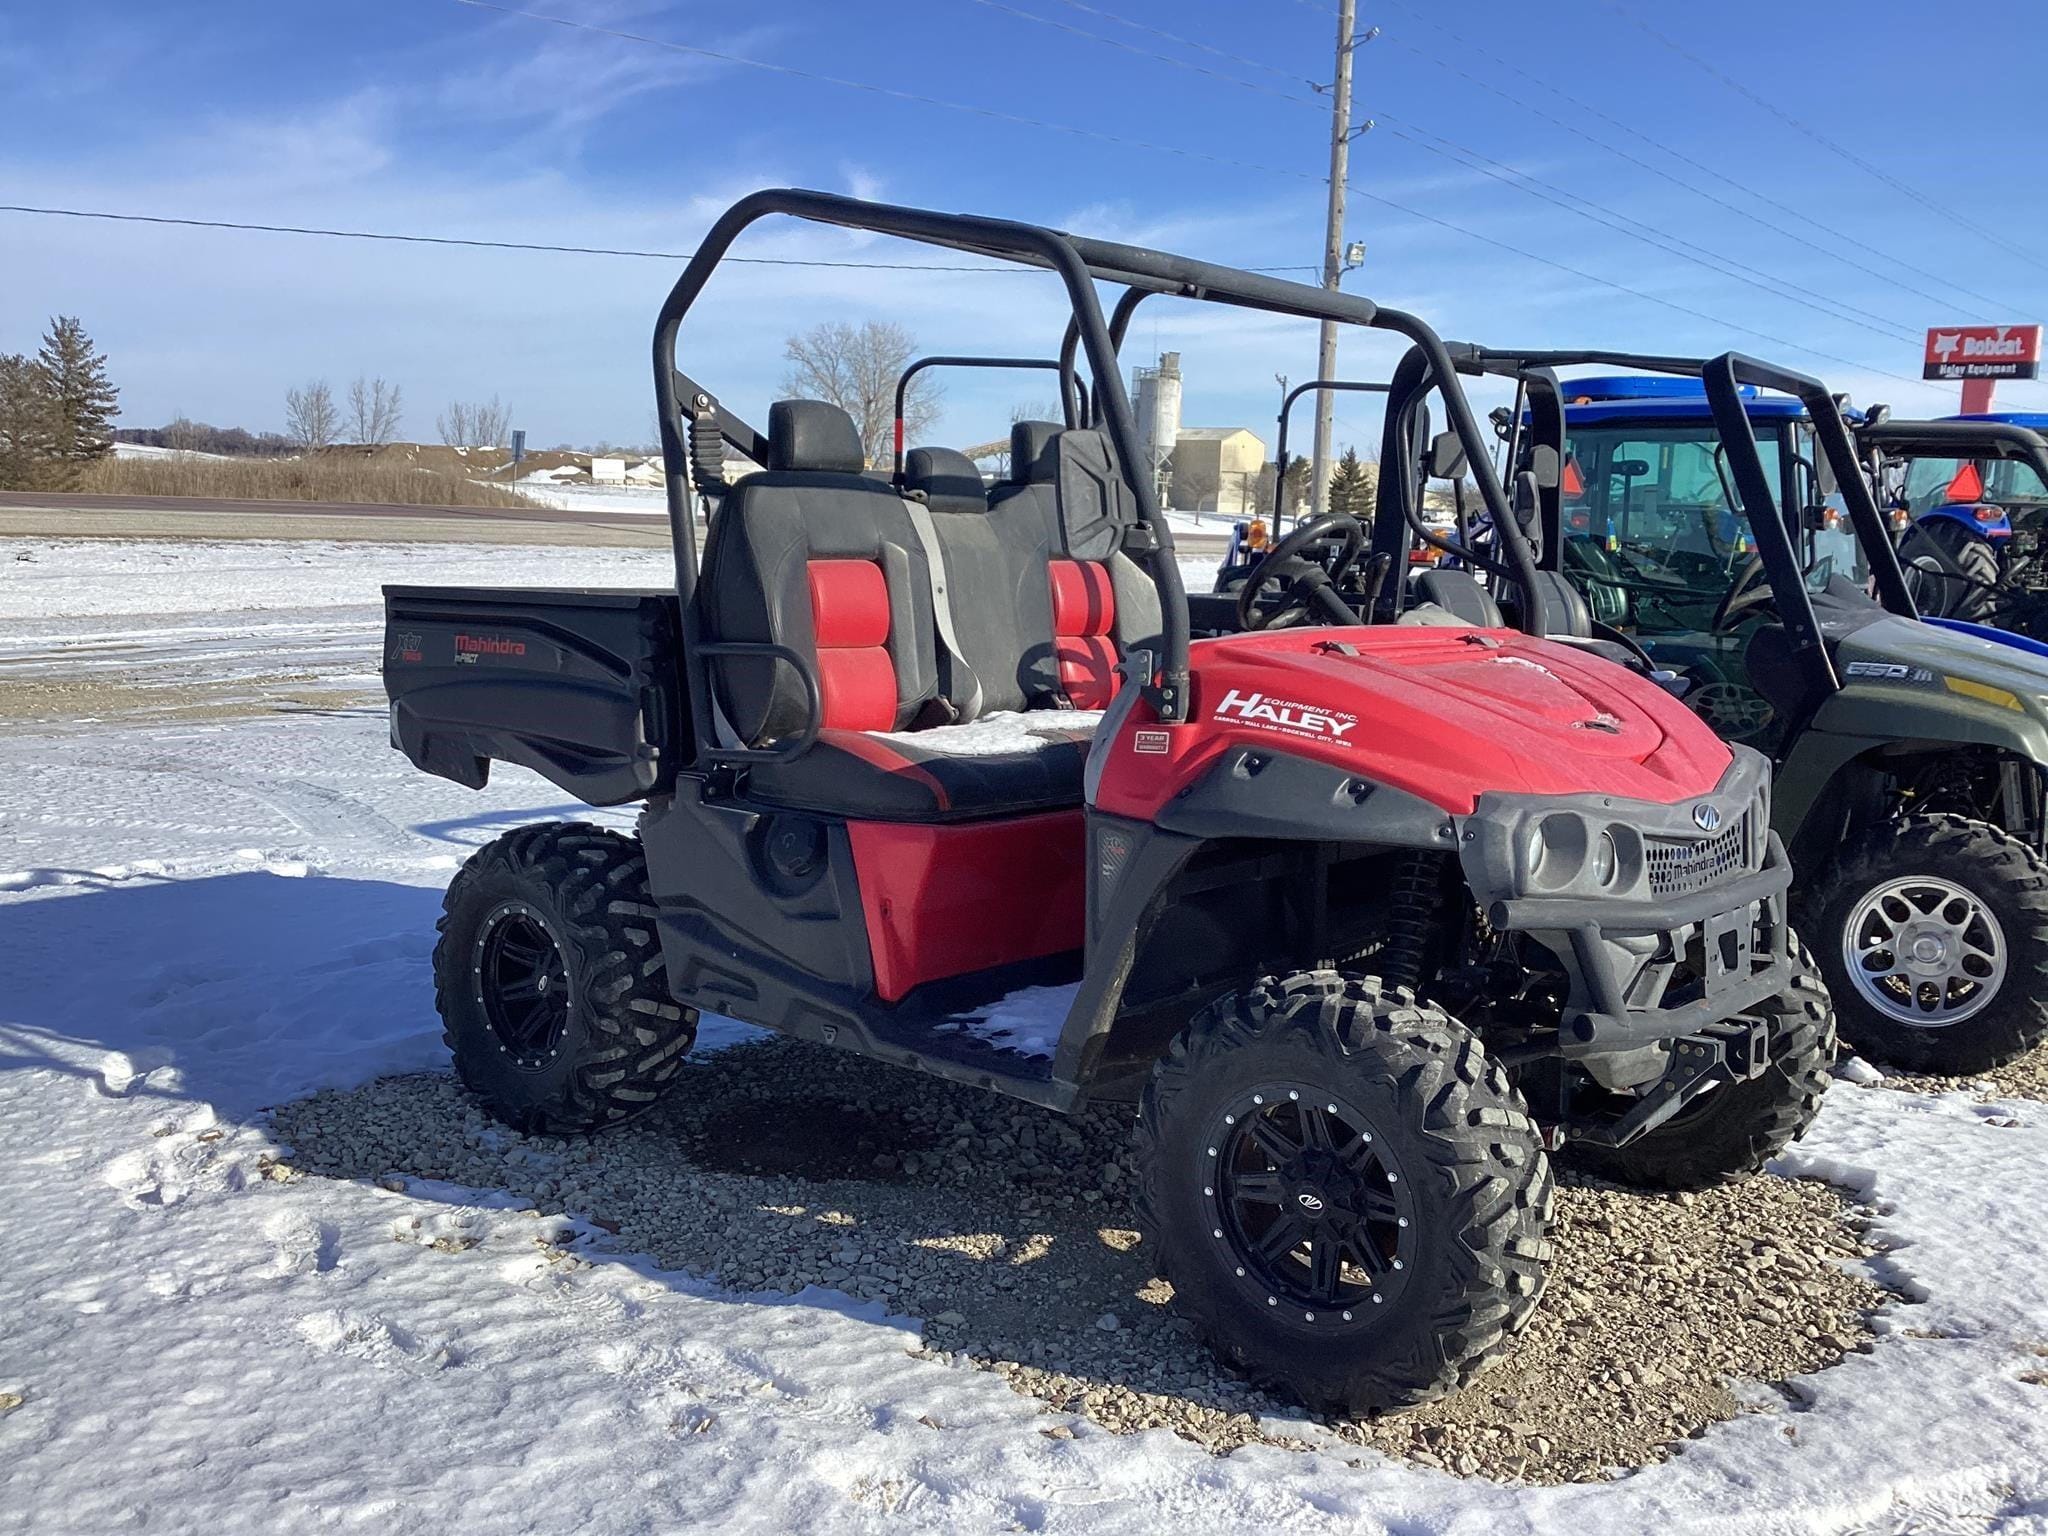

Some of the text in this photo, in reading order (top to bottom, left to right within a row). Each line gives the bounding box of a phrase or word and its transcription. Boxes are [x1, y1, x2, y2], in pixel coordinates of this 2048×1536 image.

[1963, 336, 2025, 356] Bobcat
[1939, 363, 2017, 377] Haley Equipment
[455, 634, 526, 656] Mahindra
[1215, 689, 1357, 736] HALEY
[1262, 697, 1359, 722] EQUIPMENT INC.
[1673, 856, 1715, 879] Mahindra
